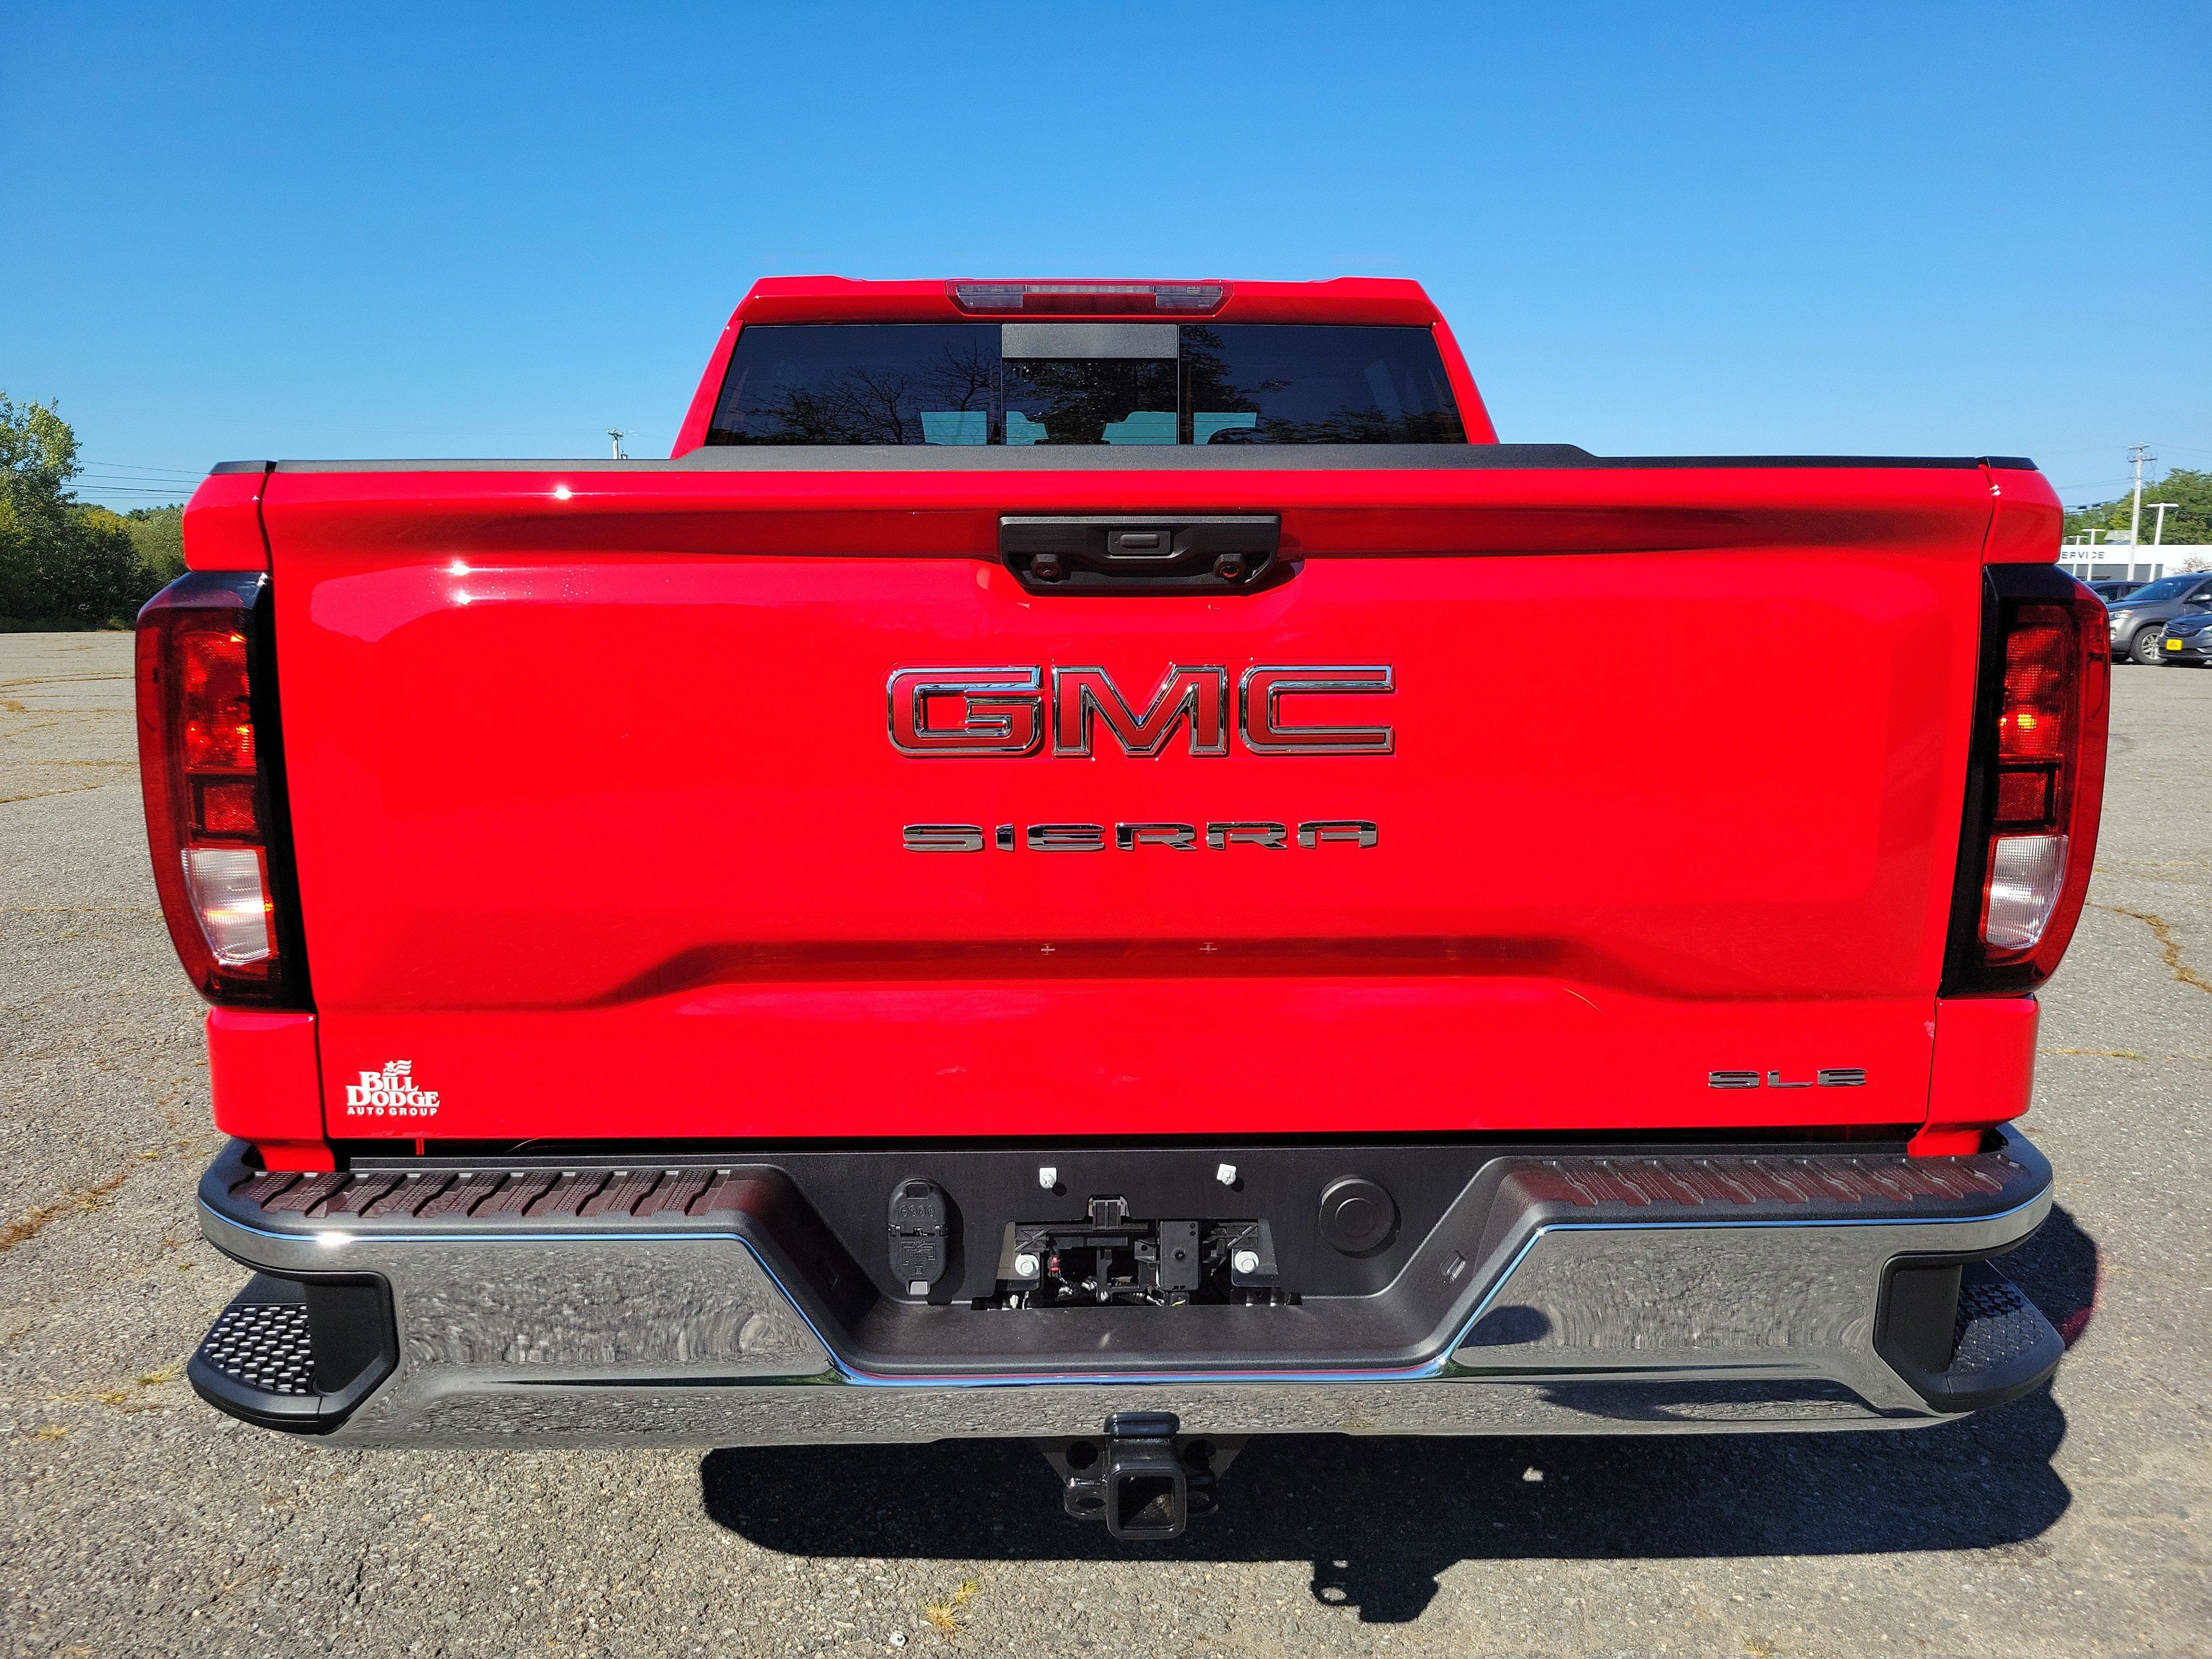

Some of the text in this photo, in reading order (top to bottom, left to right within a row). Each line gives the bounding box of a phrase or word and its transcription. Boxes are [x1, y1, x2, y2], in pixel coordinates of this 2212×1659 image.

[886, 663, 1396, 757] GMC
[902, 821, 1379, 853] SIERRA
[359, 1071, 419, 1092] BILL
[1708, 1069, 1867, 1088] SLE
[346, 1085, 440, 1107] DODGE
[347, 1107, 437, 1116] AUTO GROUP
